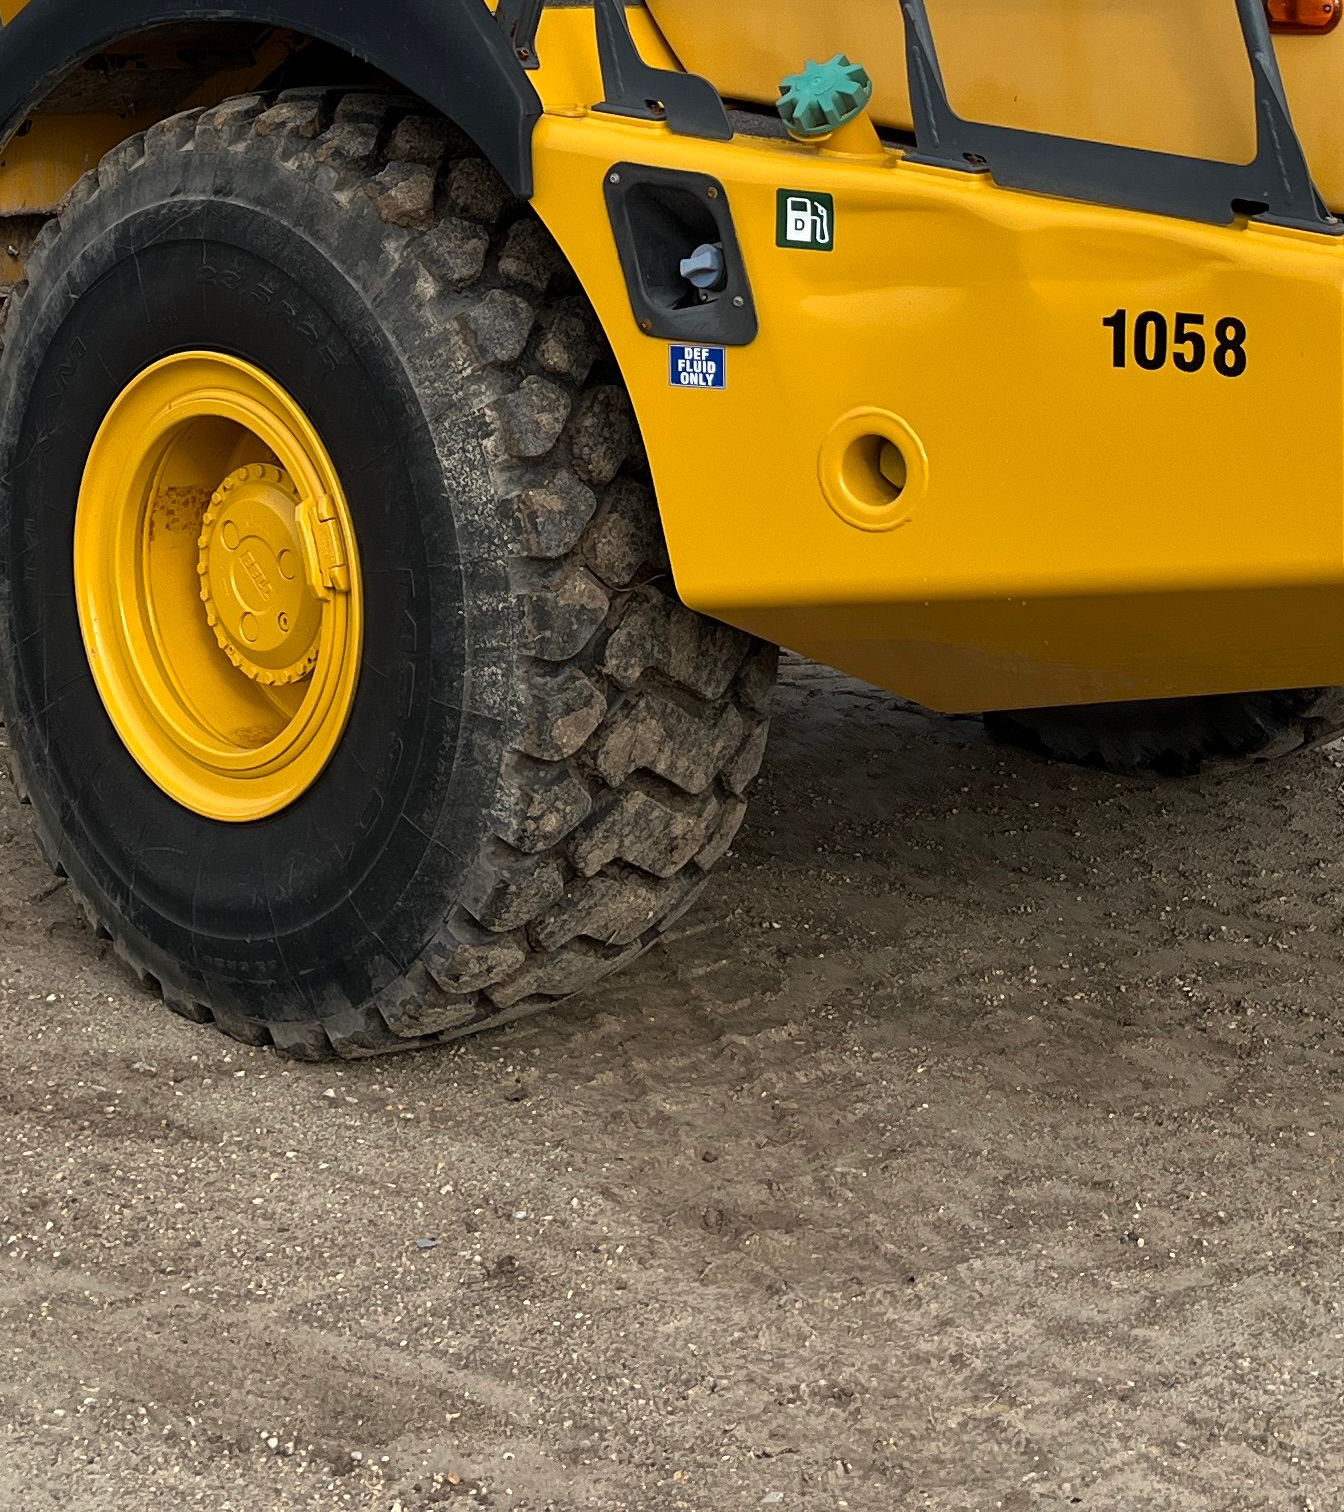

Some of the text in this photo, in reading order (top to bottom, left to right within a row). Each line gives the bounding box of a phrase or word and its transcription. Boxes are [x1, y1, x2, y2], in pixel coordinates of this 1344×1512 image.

[794, 218, 805, 231] D
[1102, 309, 1247, 378] 1058
[684, 347, 709, 360] DEF
[677, 359, 716, 373] FLUID
[680, 372, 714, 386] ONLY
